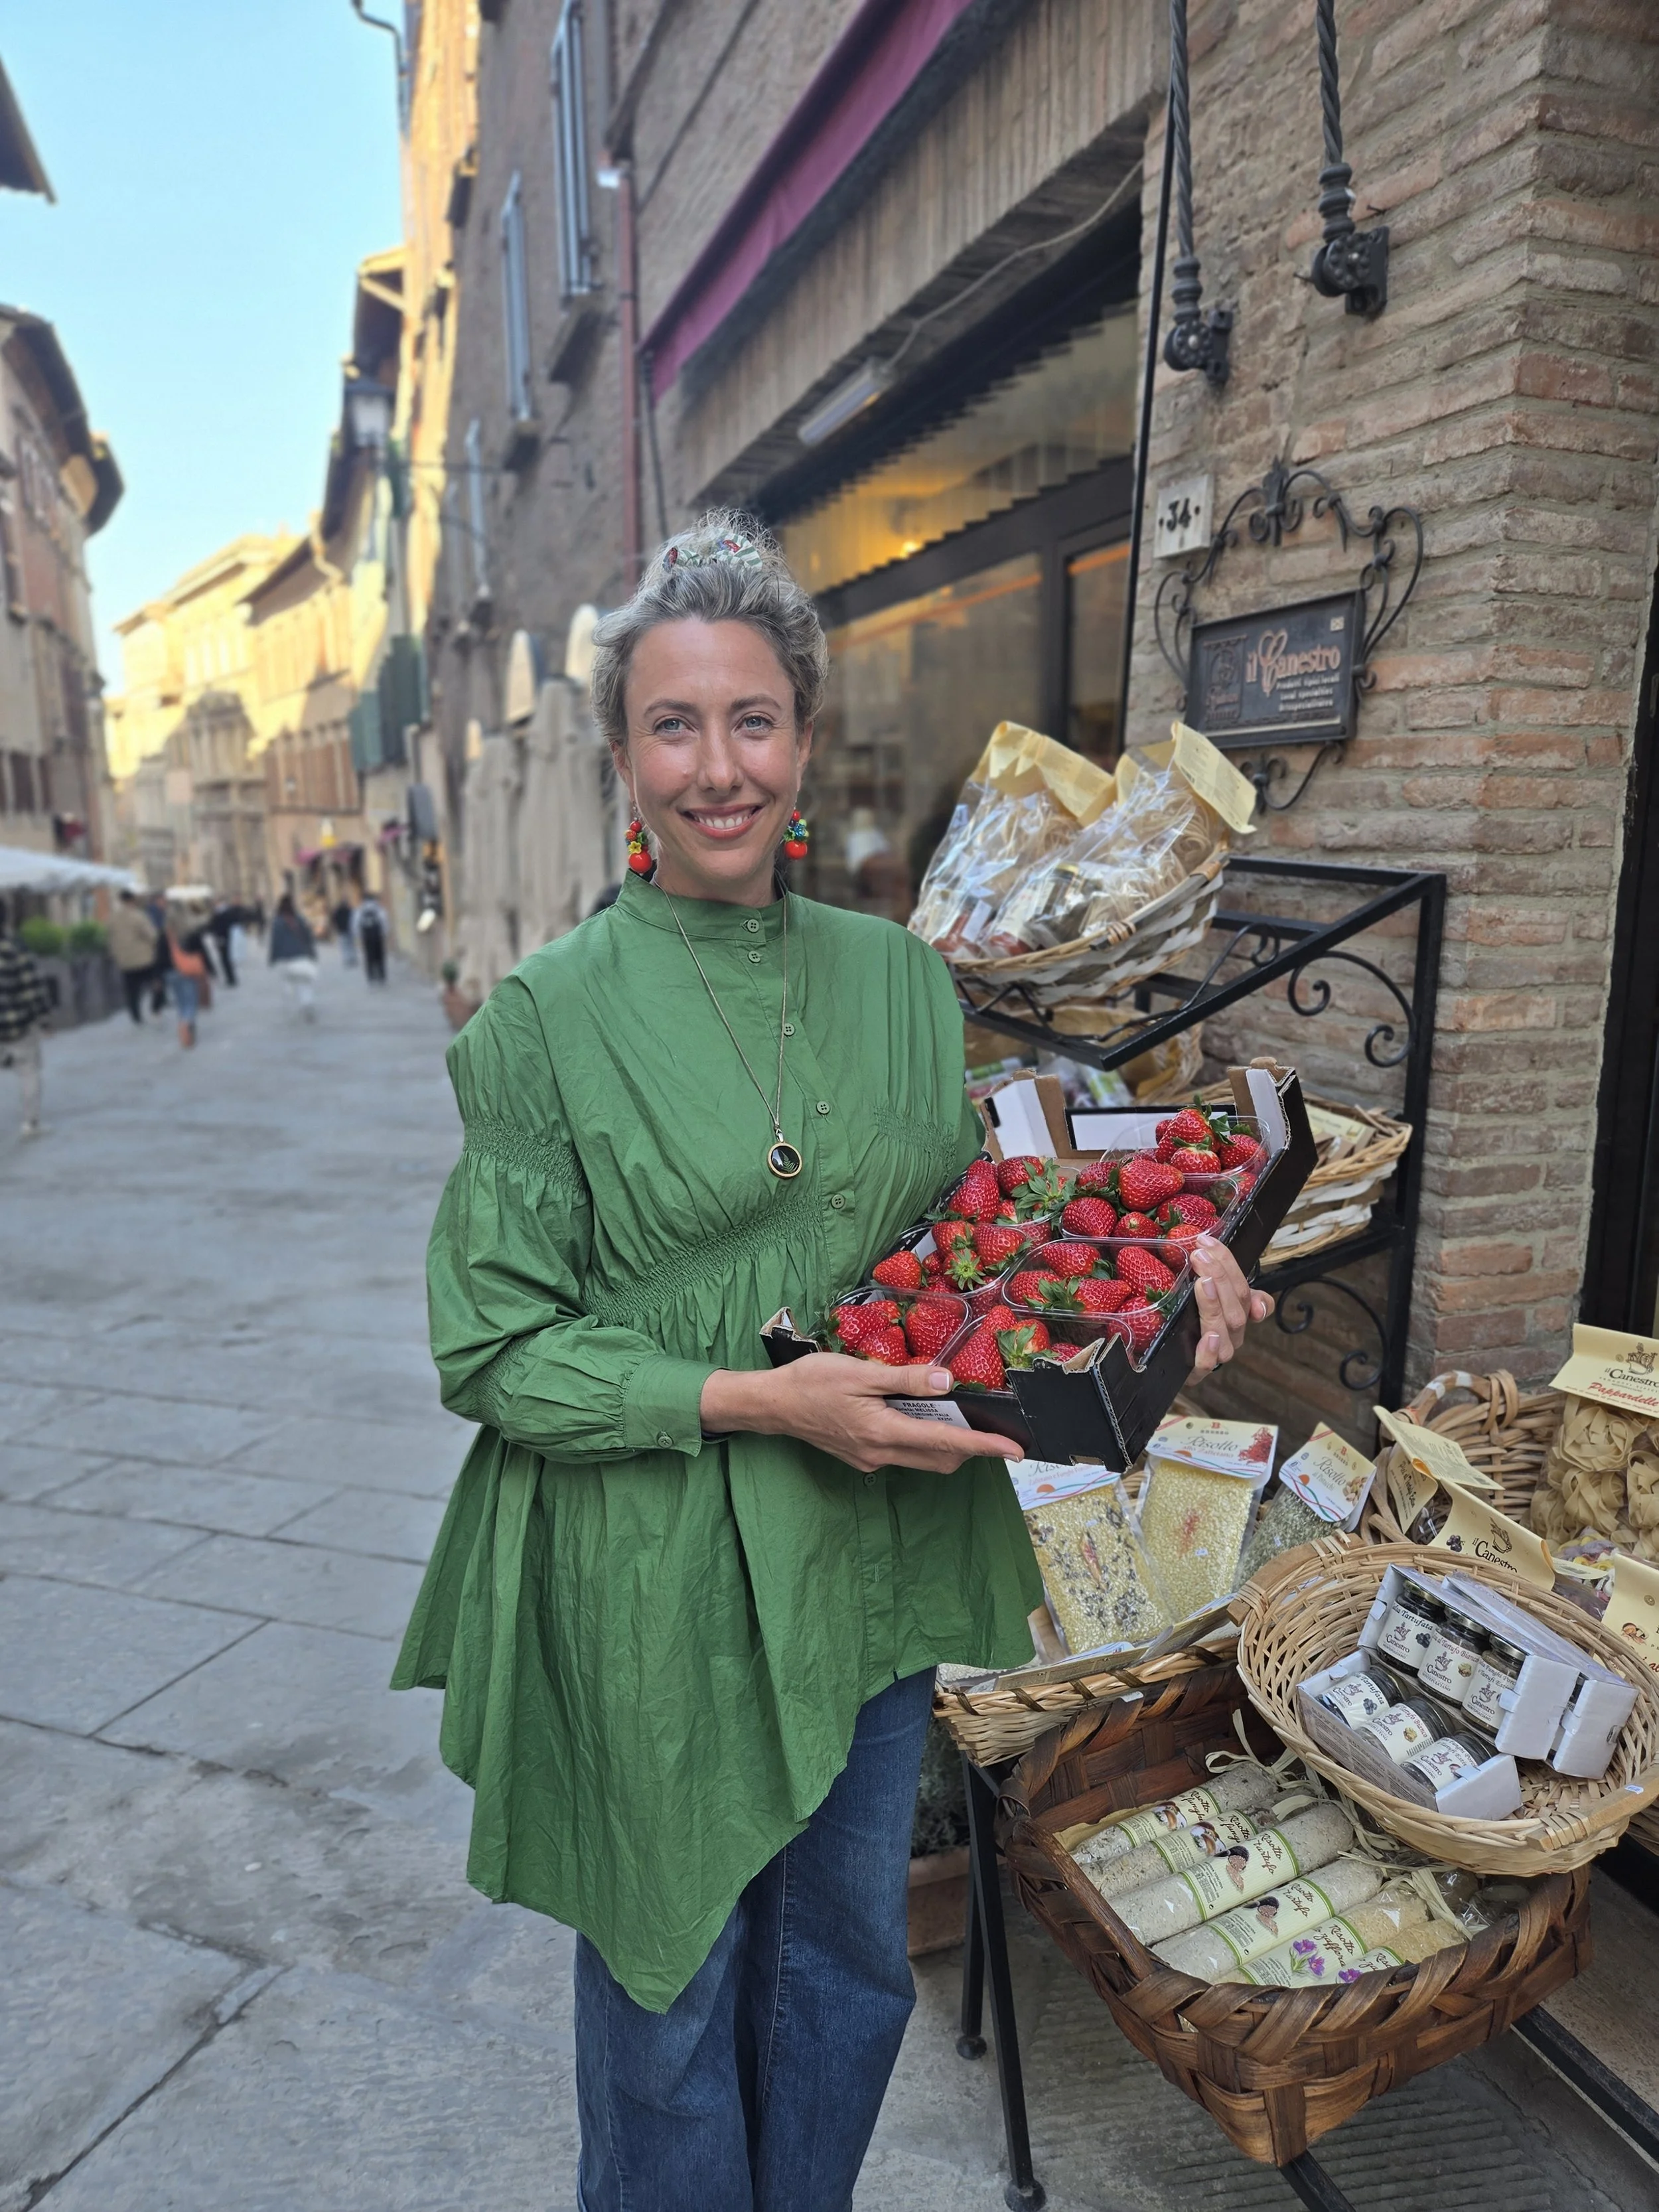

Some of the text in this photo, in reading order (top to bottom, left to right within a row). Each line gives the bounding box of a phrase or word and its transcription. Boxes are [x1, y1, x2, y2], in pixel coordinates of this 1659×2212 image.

[1167, 498, 1192, 533] 34
[1246, 651, 1258, 683] il
[1259, 629, 1341, 698] Canestro
[1587, 1382, 1659, 1407] Pappardelle
[1181, 1436, 1240, 1451] Risotto
[1313, 1455, 1346, 1486] Risotto
[1472, 1538, 1479, 1546] il
[1401, 1609, 1433, 1631] Tartufata
[1386, 1634, 1410, 1653] Canestro
[1441, 1639, 1461, 1655] Tartufo
[1461, 1650, 1480, 1663] Bianco
[1427, 1664, 1452, 1684] Canestro
[1360, 1676, 1385, 1705] Tartufata
[1471, 1695, 1495, 1715] Canestro
[1413, 1718, 1428, 1738] Bianco
[1420, 1755, 1443, 1776] Canestro
[1189, 1791, 1210, 1814] Risotto
[1228, 1814, 1252, 1840] Risotto
[1254, 1838, 1277, 1876] tartufo
[1260, 1833, 1283, 1862] Risotto
[1282, 1889, 1311, 1918] tartufo
[1290, 1882, 1315, 1903] Risotto
[1329, 1923, 1355, 1956] Risotto
